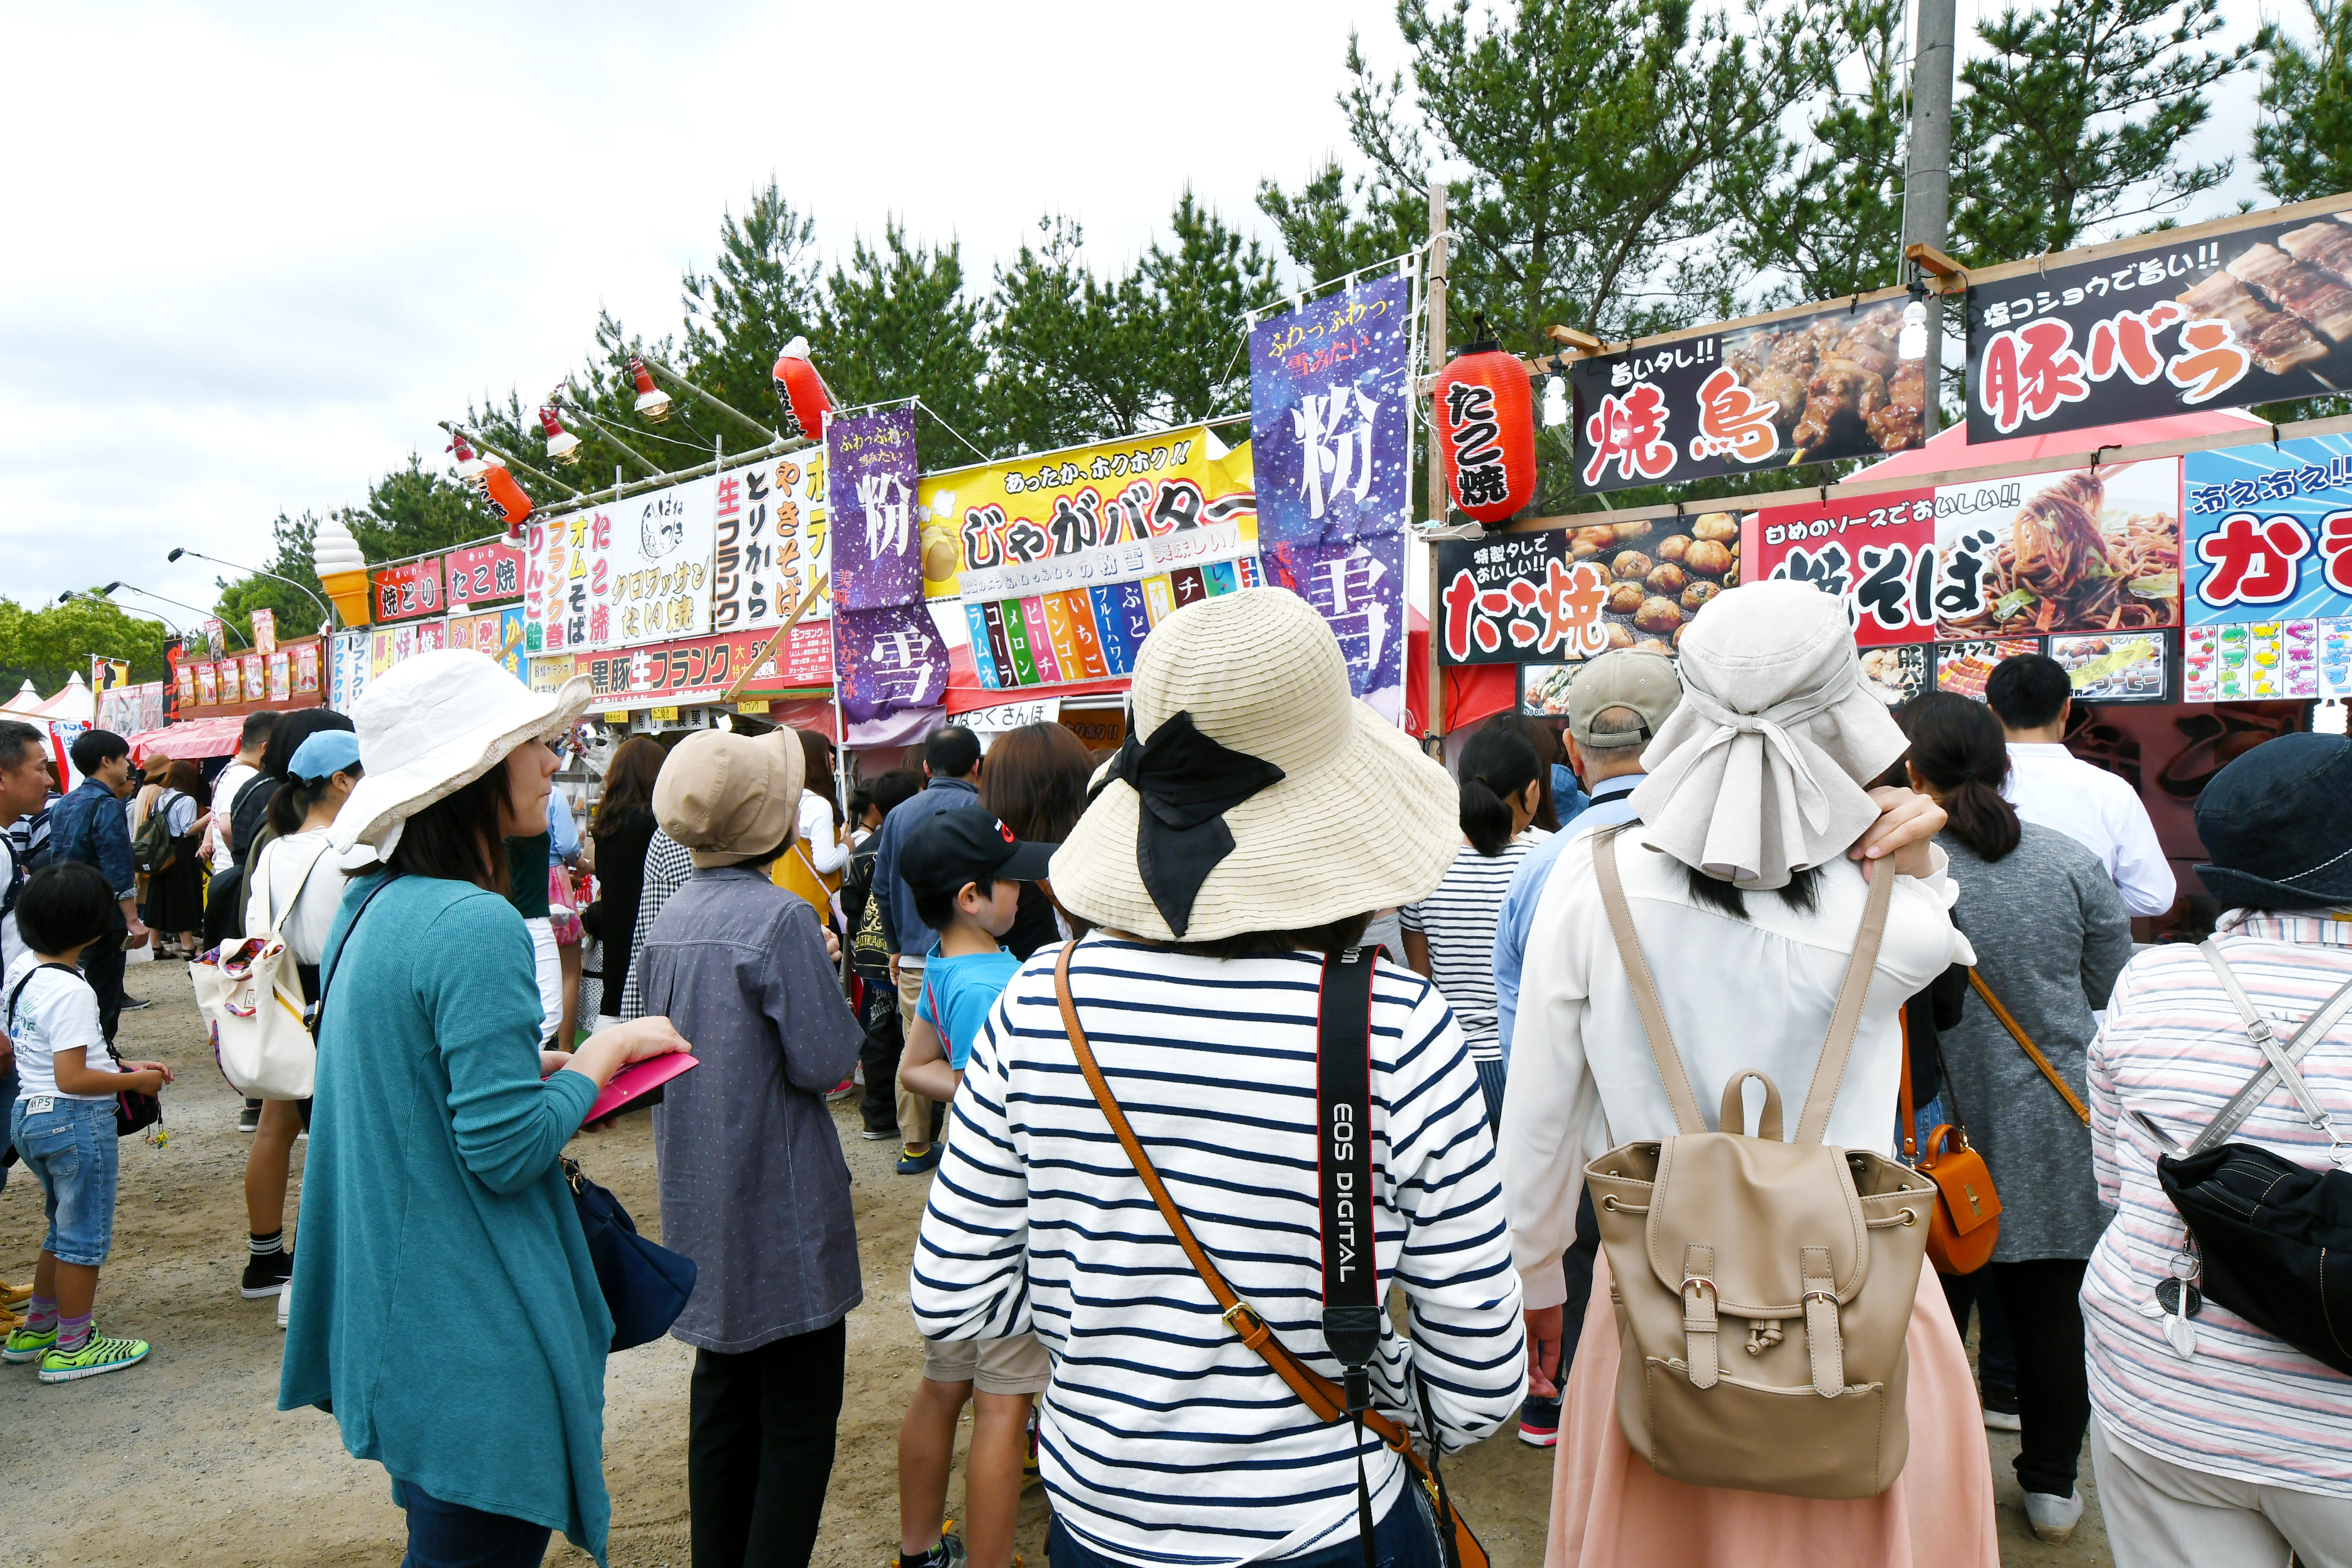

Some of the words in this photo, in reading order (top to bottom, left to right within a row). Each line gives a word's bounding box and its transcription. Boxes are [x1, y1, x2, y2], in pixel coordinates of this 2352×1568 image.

[1268, 299, 1387, 358] ふわっふわっ
[1288, 336, 1370, 379] 雪みたい
[1980, 300, 2249, 434] 豚バラ
[840, 426, 910, 452] ふわっふわっ
[1444, 380, 1509, 509] たこ焼
[1583, 366, 1780, 486] 焼鳥
[717, 476, 740, 628] 生フランク
[746, 470, 771, 623] とりから
[774, 460, 800, 617] やきそば
[961, 478, 1257, 570] じゃがバター
[1765, 483, 2021, 545] 甘めのソースでおいしい!!
[395, 569, 417, 578] めいわ
[452, 558, 516, 601] たこ焼
[468, 549, 494, 562] めいわ
[526, 526, 543, 651] りんご飴
[545, 520, 567, 649] フランク巻
[568, 516, 587, 645] オムそば
[590, 511, 612, 644] たこ焼
[612, 553, 710, 605] クロワッサン
[1178, 576, 1199, 601] チ
[1476, 554, 1545, 584] おいしい!!
[381, 577, 435, 618] 焼とり
[622, 594, 694, 639] たい焼
[832, 569, 859, 700] 美味しいかき氷
[1069, 597, 1102, 674] いちご
[1095, 587, 1125, 674] ブルーハワイ
[1442, 556, 1610, 661] たこ焼
[591, 643, 730, 694] 黒豚生フランク
[734, 644, 745, 661] 大
[969, 607, 997, 688] ラムネ
[986, 605, 1013, 687] コーラ
[1009, 608, 1031, 676] メロン
[1024, 604, 1054, 677] ピーチ
[1045, 599, 1075, 679] マンゴー
[1939, 640, 1998, 658] フランク
[2186, 625, 2216, 701] いちご
[2220, 623, 2247, 700] めろん
[2251, 622, 2280, 698] れもん
[2284, 620, 2316, 697] ぐれーぷ
[1003, 703, 1046, 725] さんぽ
[1523, 707, 1545, 716] 500円
[2092, 671, 2161, 691] コーヒー
[28, 1098, 51, 1110] MPS
[1333, 1102, 1353, 1161] EOS
[1337, 1172, 1357, 1284] DIGITAL
